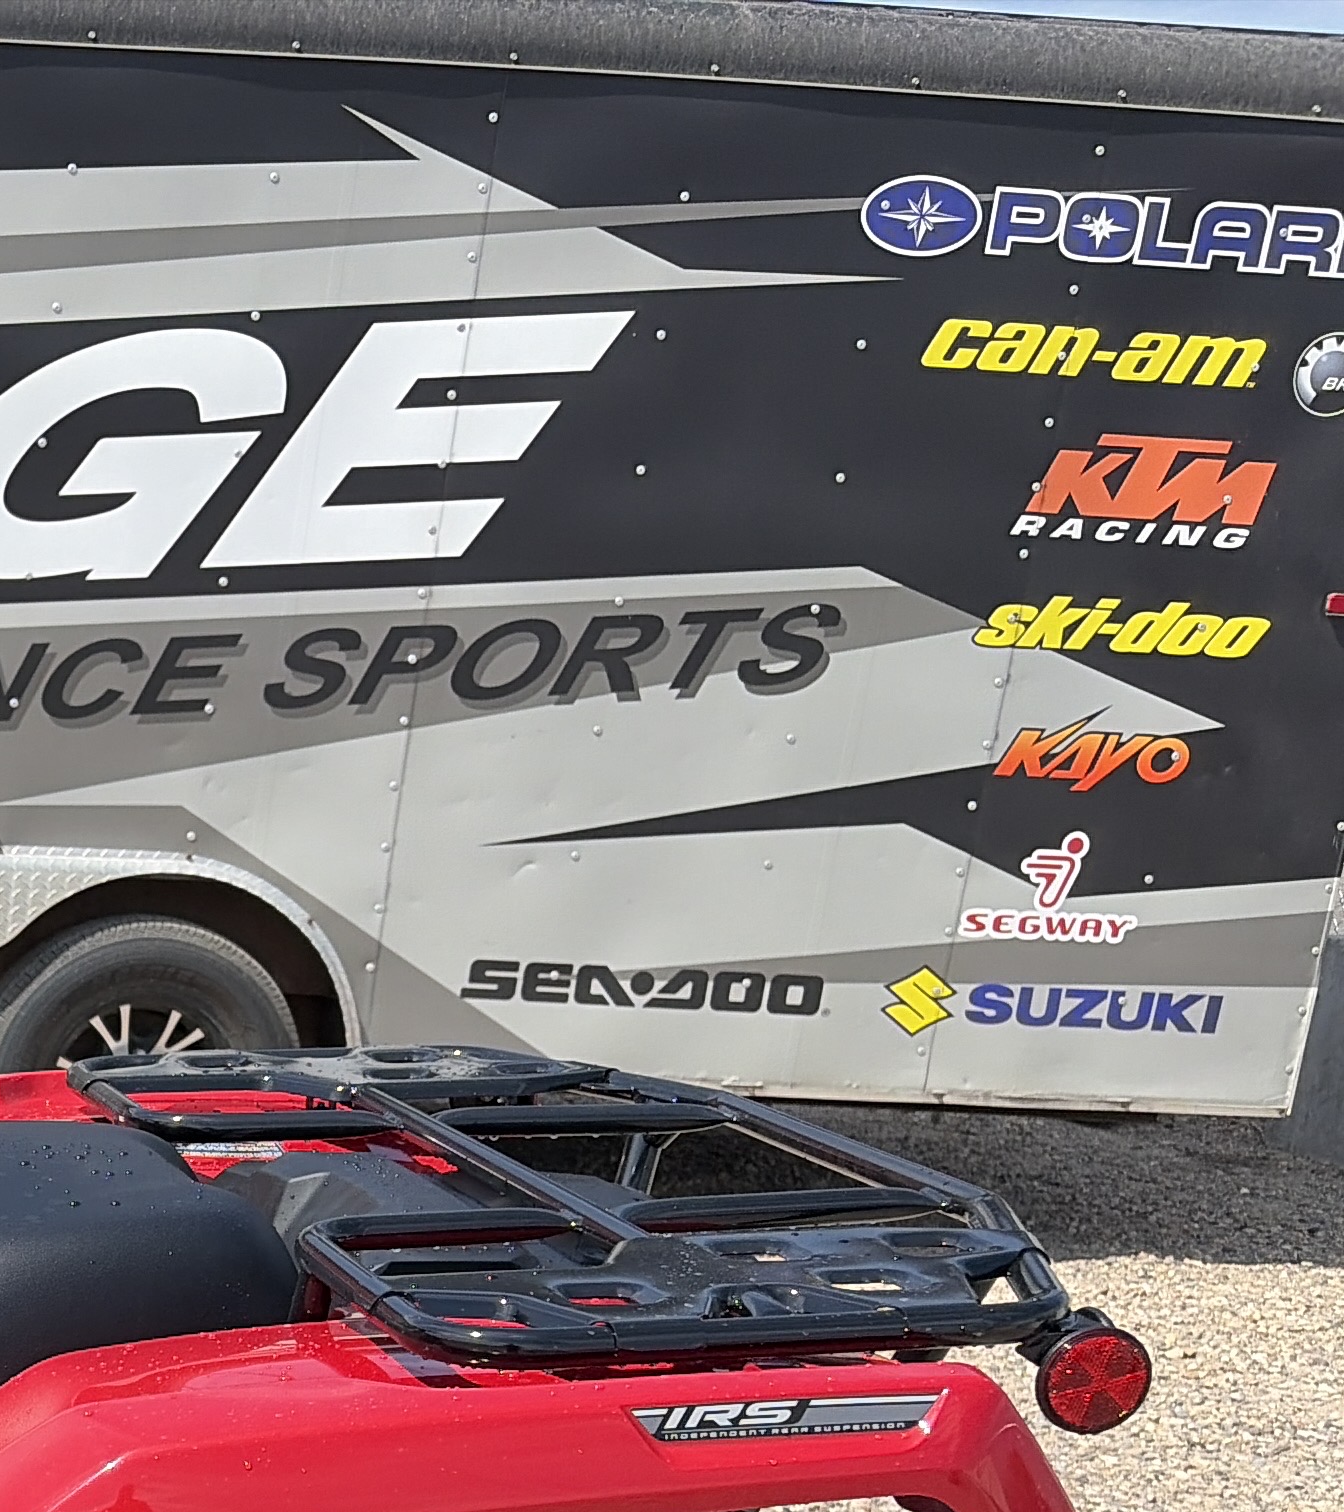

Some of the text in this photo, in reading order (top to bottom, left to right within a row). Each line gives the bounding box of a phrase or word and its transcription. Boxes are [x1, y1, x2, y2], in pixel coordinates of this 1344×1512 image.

[921, 316, 1267, 390] can-am
[1030, 433, 1278, 527] KTM
[1010, 514, 1252, 550] RACING
[971, 594, 1273, 660] ski-doo
[261, 602, 842, 712] SPORTS
[993, 705, 1190, 792] KAYO
[962, 911, 1132, 941] SEGWAY
[964, 983, 1223, 1035] SUZUKI
[663, 1400, 798, 1429] IRS
[771, 1425, 809, 1434] REAR
